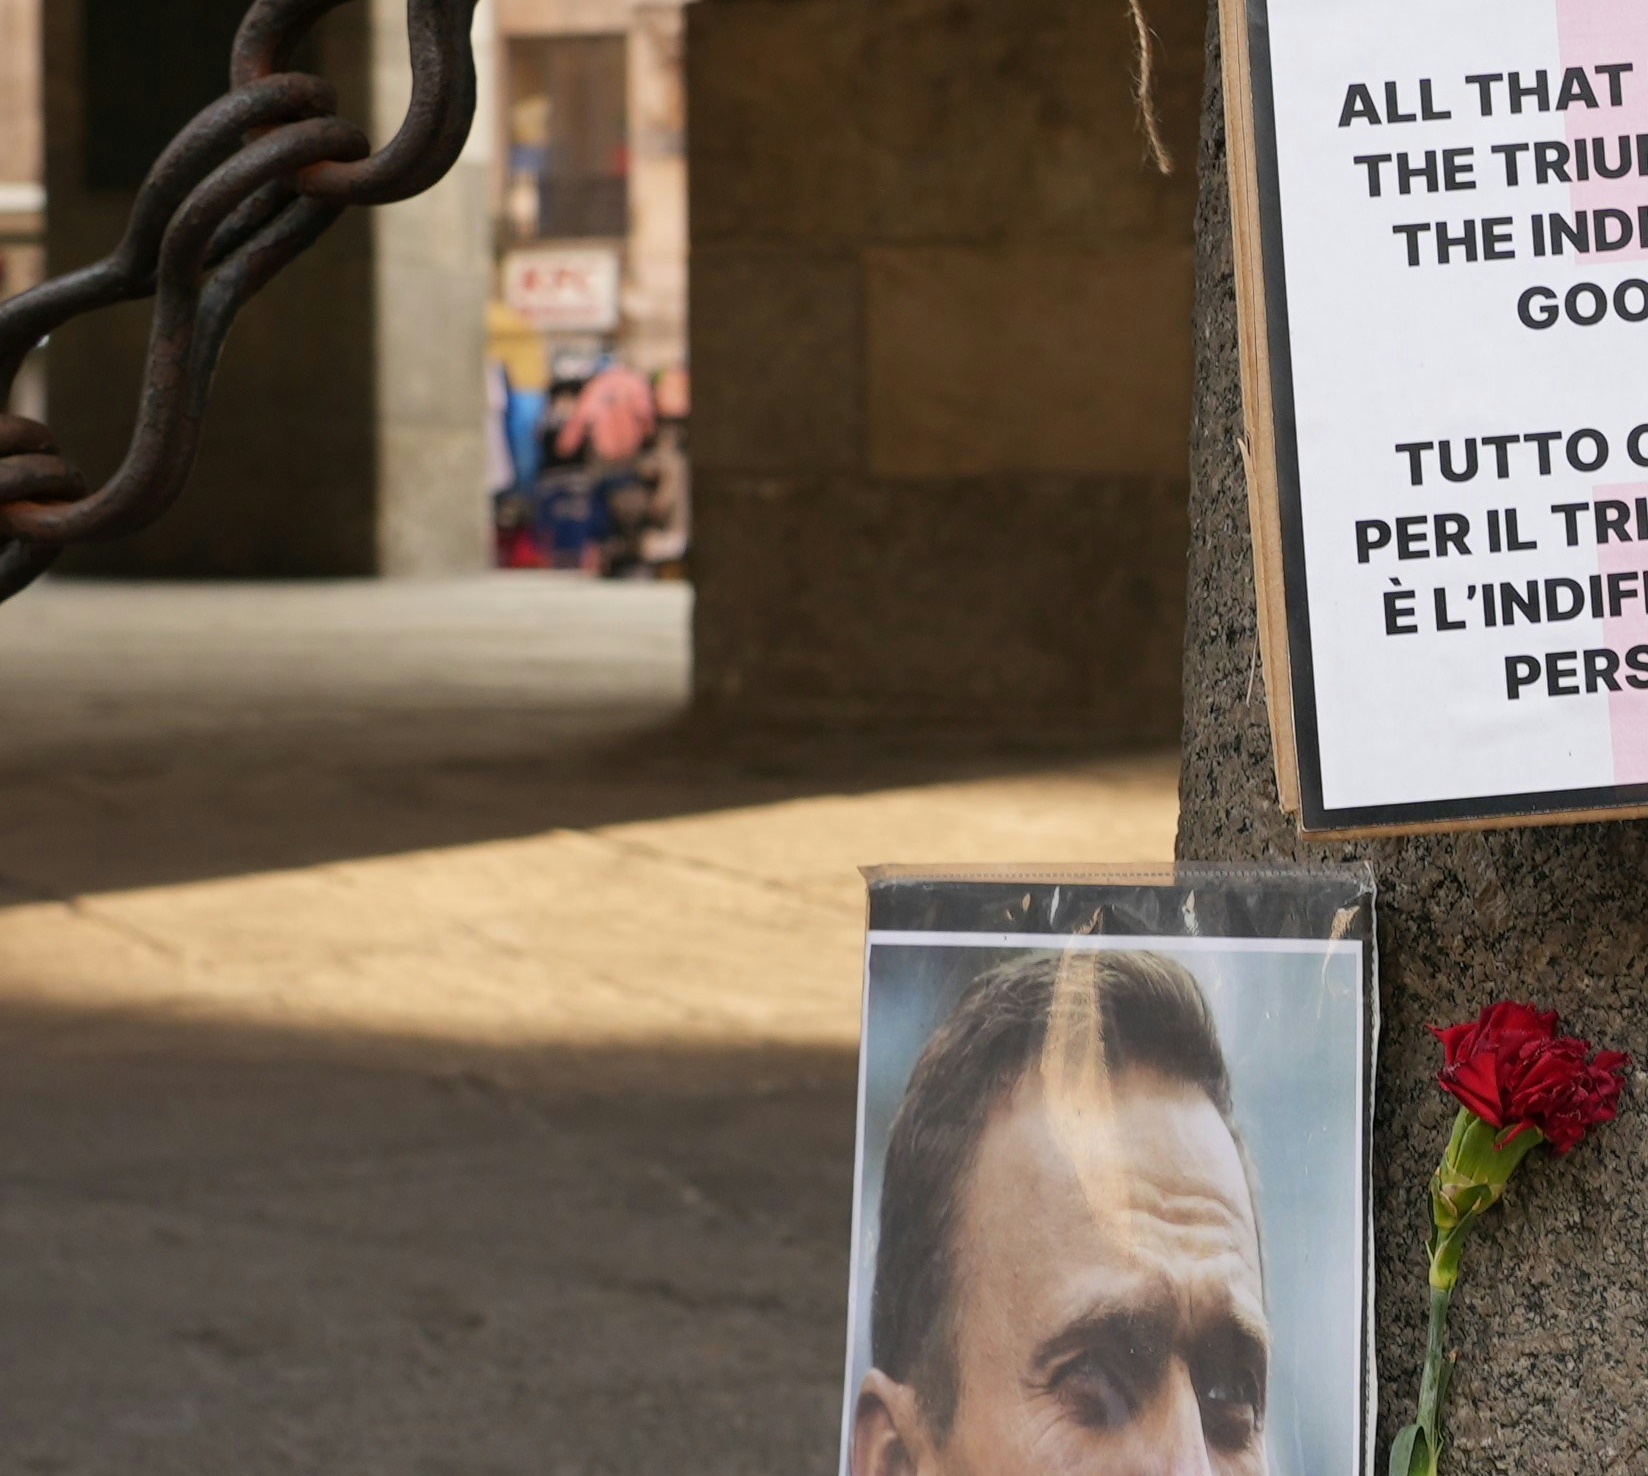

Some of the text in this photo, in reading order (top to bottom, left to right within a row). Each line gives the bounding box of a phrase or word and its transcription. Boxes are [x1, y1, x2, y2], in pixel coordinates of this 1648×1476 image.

[1339, 79, 1451, 127] ALL
[1465, 63, 1633, 116] THAT
[1354, 148, 1476, 196] THE
[1393, 217, 1515, 266] THE
[1396, 429, 1608, 485] TUTTO
[1356, 514, 1471, 563] PER
[1487, 509, 1537, 552] IL
[1384, 574, 1417, 635] È
